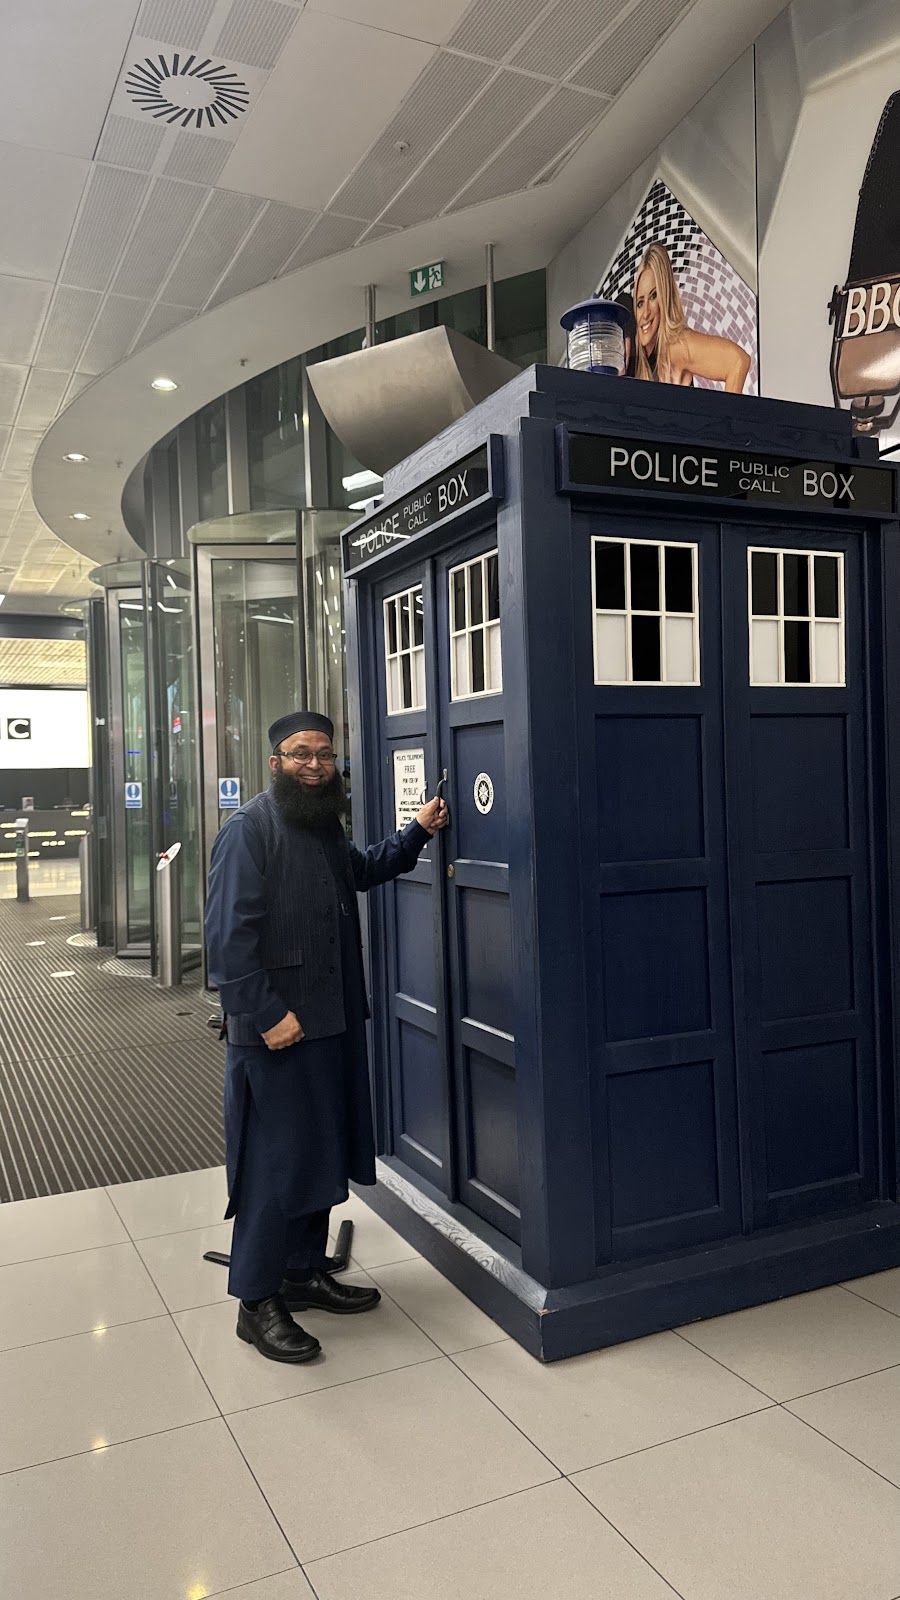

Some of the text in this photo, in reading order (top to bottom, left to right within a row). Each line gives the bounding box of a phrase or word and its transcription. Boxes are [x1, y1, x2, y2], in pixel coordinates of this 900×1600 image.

[610, 446, 856, 501] POLICE PUBLIC CALL BOX
[359, 469, 469, 558] POLICE PUBLIC CALL BOX
[404, 765, 416, 773] FREE
